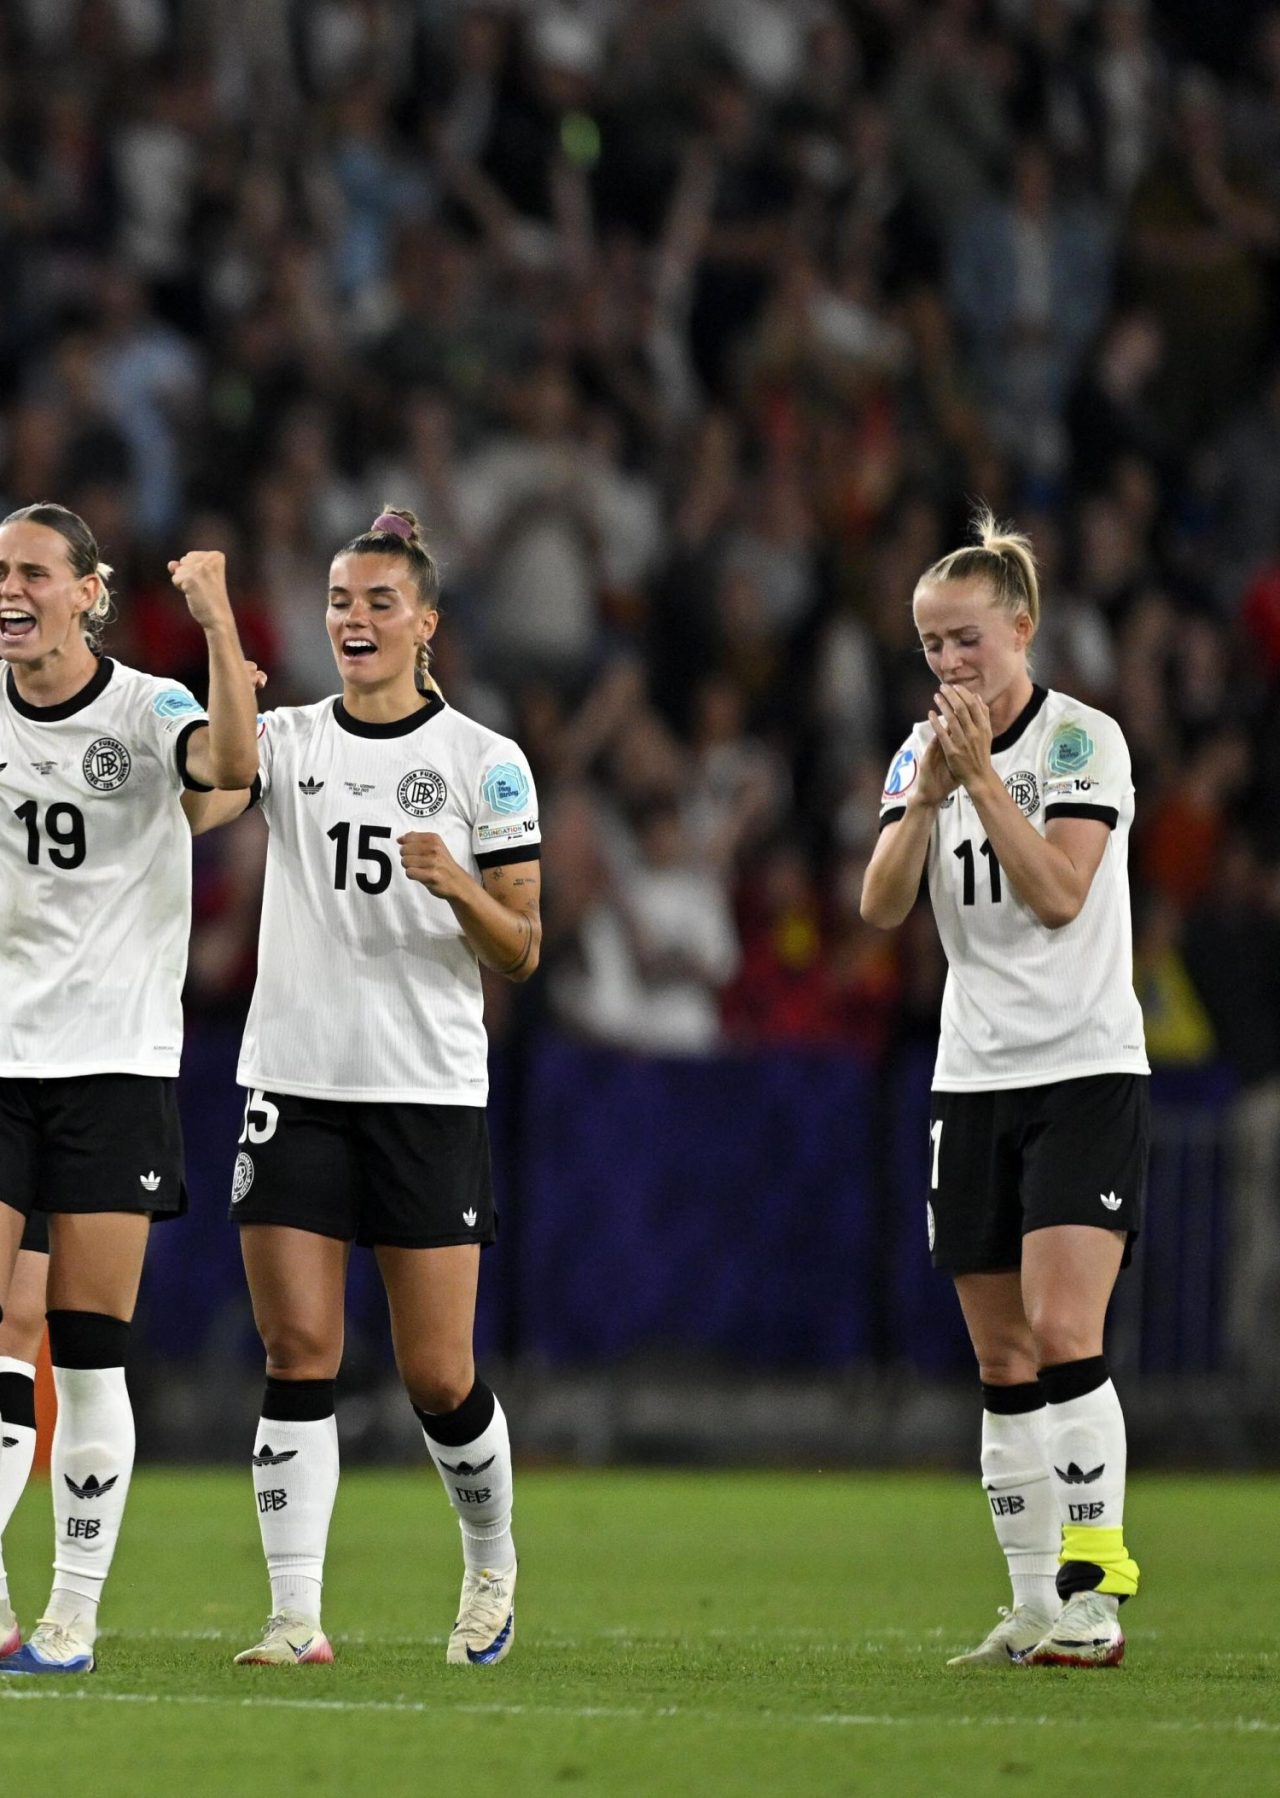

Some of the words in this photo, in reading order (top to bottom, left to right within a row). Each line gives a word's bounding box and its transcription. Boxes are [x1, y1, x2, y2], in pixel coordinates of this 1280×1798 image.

[14, 800, 86, 869] 19
[327, 822, 393, 895] 15
[953, 838, 1001, 906] 11
